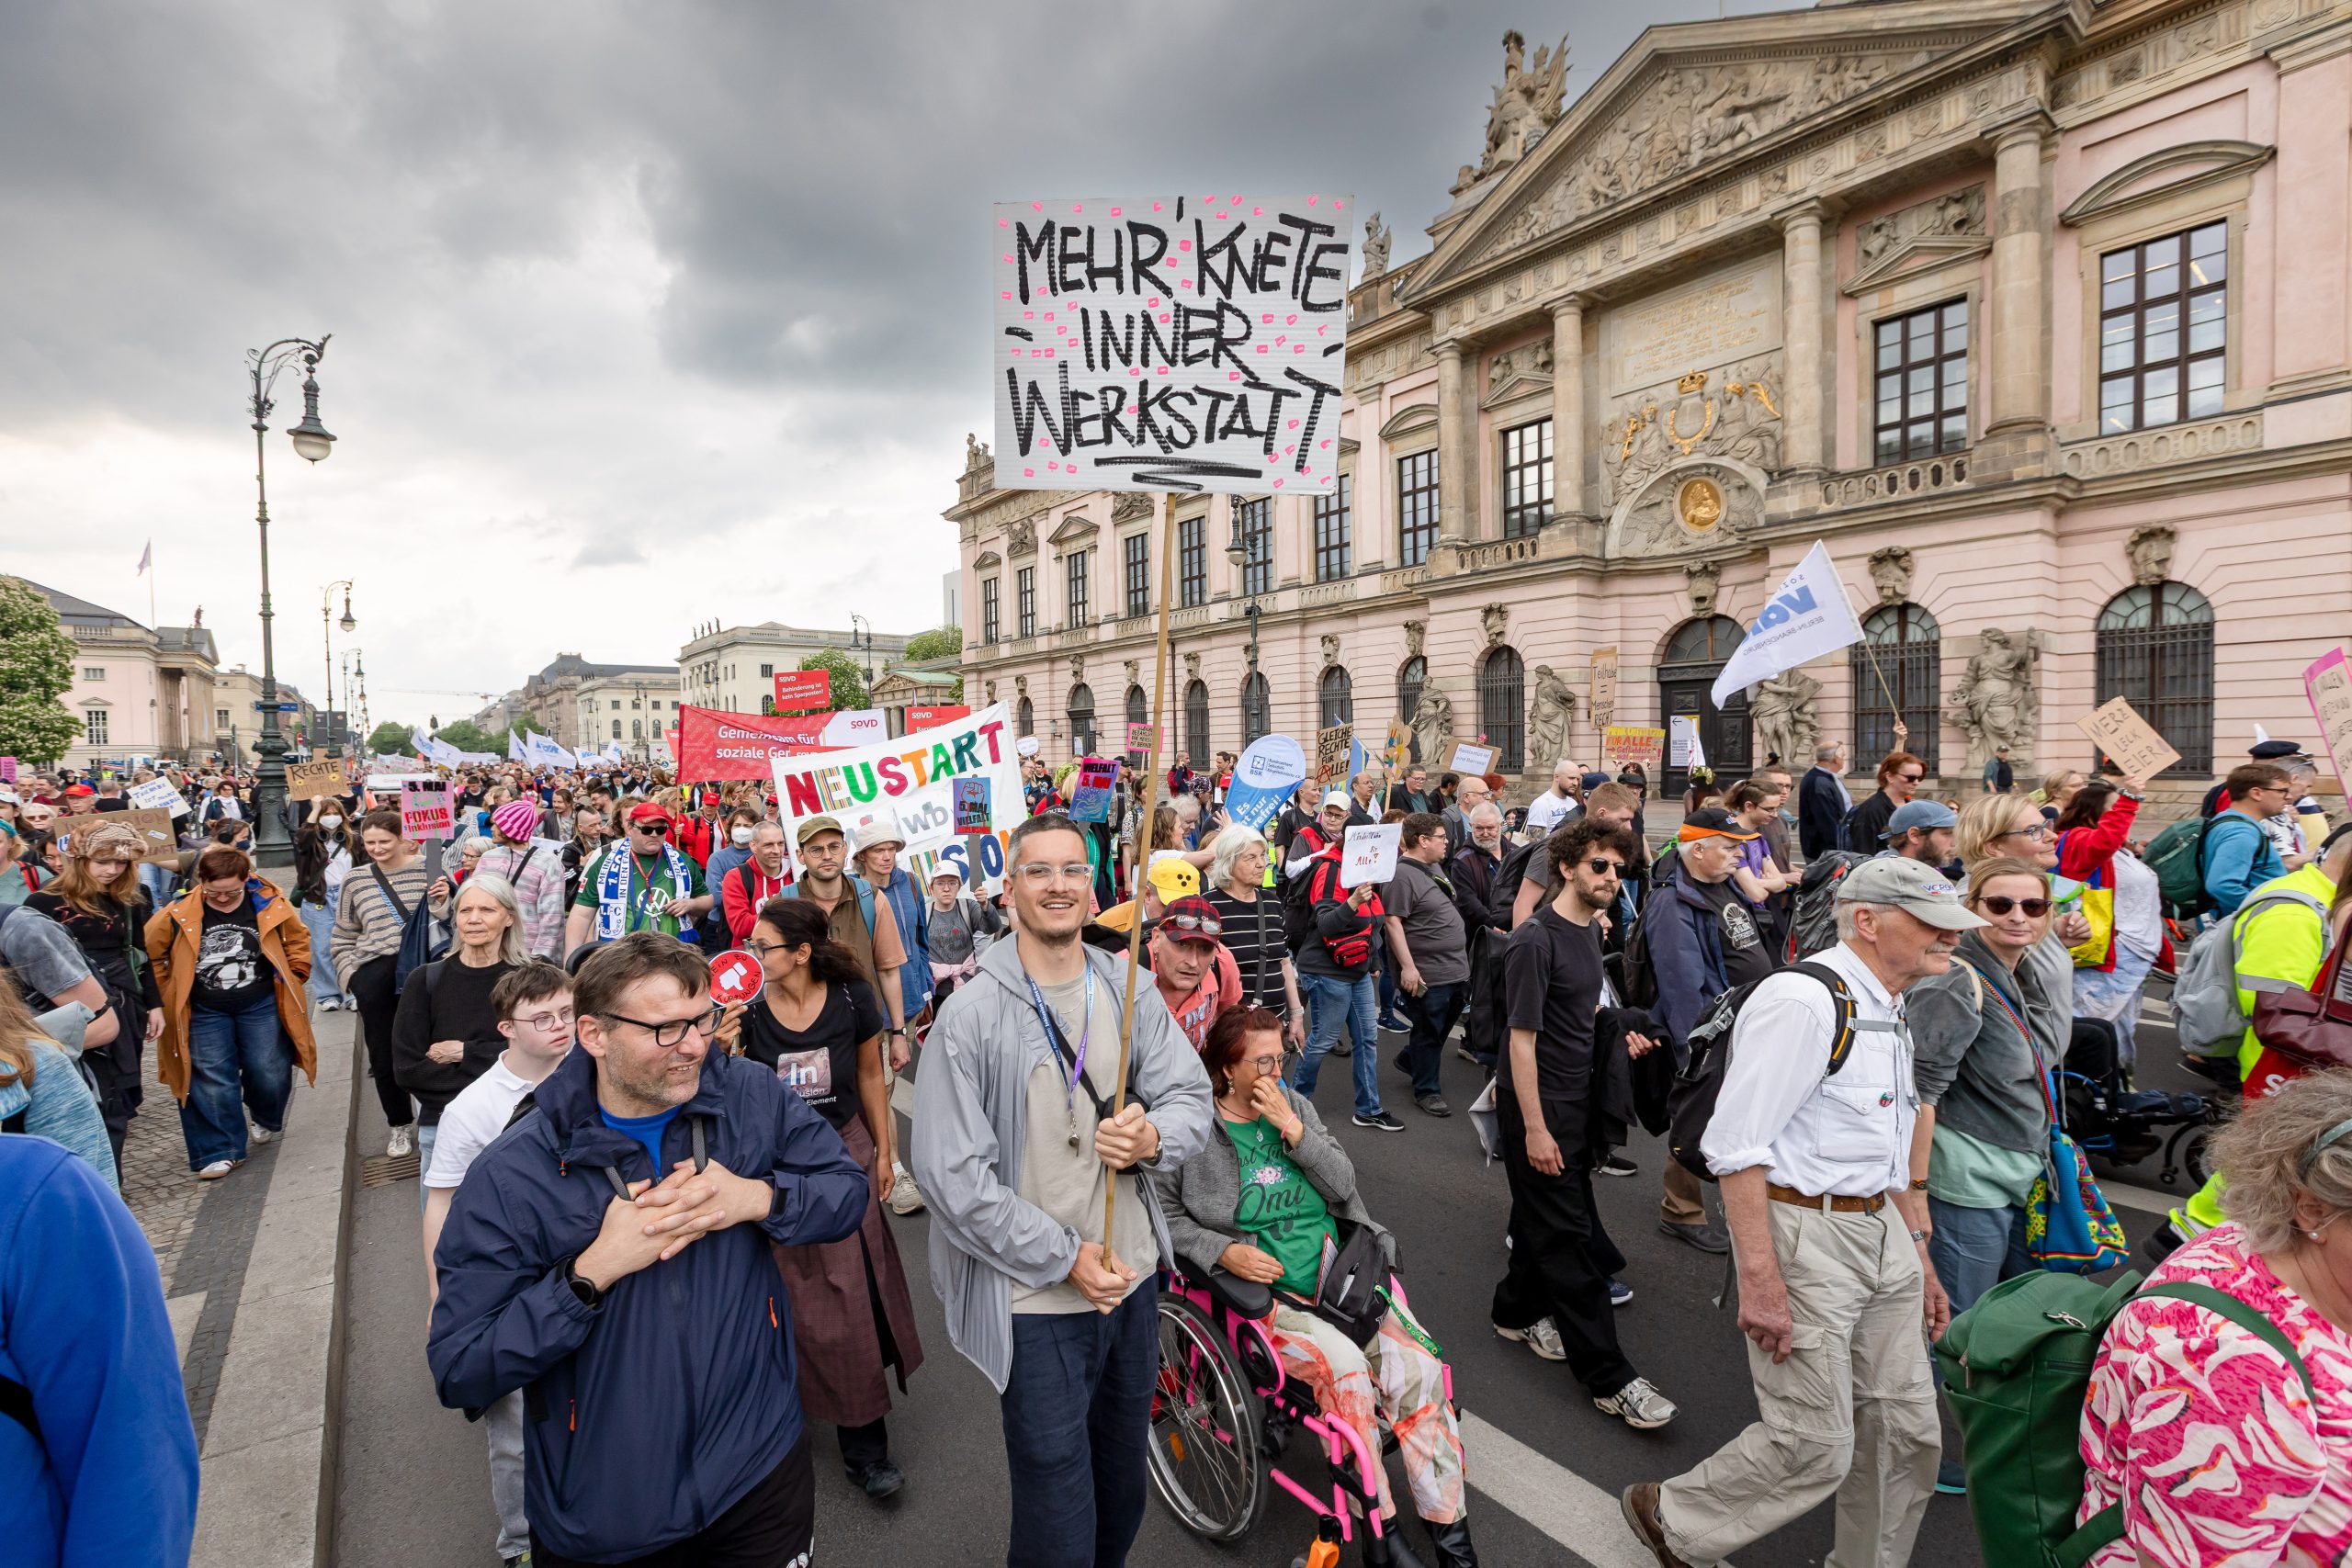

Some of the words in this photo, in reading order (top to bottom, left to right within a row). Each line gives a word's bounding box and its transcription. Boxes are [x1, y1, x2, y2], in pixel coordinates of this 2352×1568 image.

[1194, 213, 1349, 311] KNETE
[1080, 298, 1261, 381] INNER
[1006, 360, 1341, 471] WERKSTATT
[1592, 662, 1616, 680] Teilhabe
[782, 684, 815, 693] Behinderung
[794, 689, 823, 698] Sparposten!
[1594, 710, 1613, 727] RECHT
[2089, 708, 2131, 742] MERZ
[797, 733, 815, 745] für
[1317, 726, 1352, 744] GLEICHE
[1623, 736, 1653, 746] ALLE
[2114, 728, 2143, 752] LECK
[716, 747, 764, 759] soziale
[1318, 738, 1351, 758] RECHTE
[1083, 763, 1116, 773] VIELFALT
[1321, 754, 1334, 765] FÜR
[2124, 745, 2164, 773] EIER
[289, 761, 338, 781] RECHTE
[785, 720, 1003, 818] NEUSTART
[1250, 769, 1262, 777] BSK
[1315, 760, 1350, 785] ALLE!
[1236, 802, 1250, 816] Es
[1250, 795, 1267, 816] nur
[404, 808, 448, 824] FOKUS
[598, 858, 614, 885] MEINE
[620, 867, 628, 886] DEN
[619, 888, 627, 898] IN
[790, 1063, 818, 1086] In
[797, 1089, 824, 1098] lusion
[806, 1096, 837, 1106] Element
[1233, 1178, 1306, 1224] Omi
